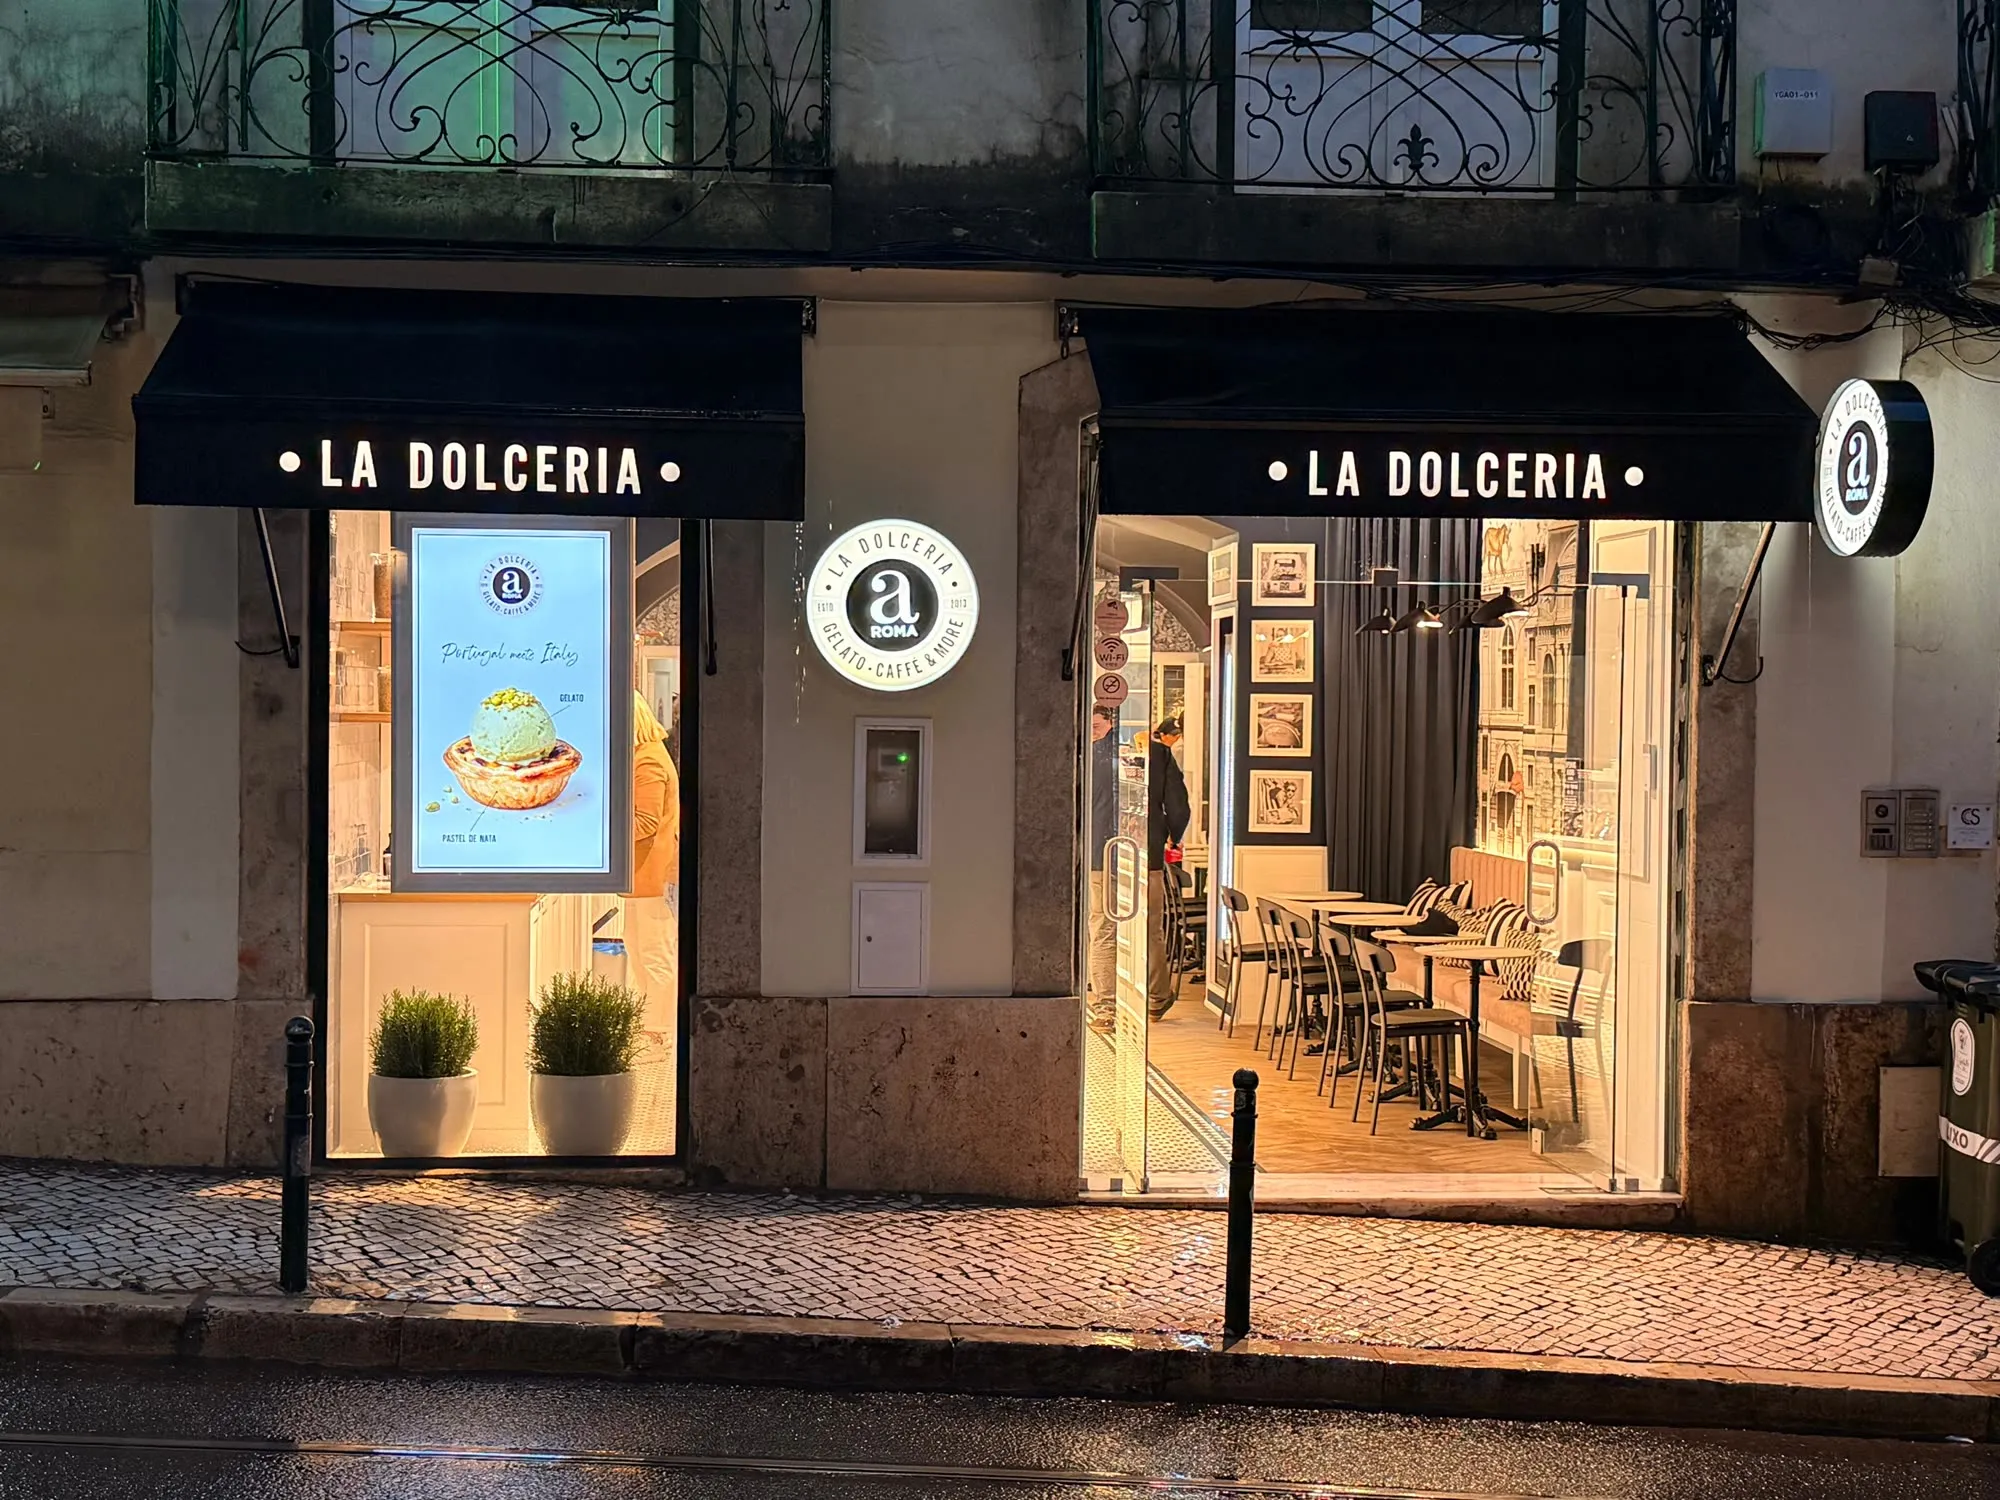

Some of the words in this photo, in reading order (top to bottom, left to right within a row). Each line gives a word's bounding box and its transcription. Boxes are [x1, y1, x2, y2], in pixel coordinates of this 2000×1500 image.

[321, 439, 378, 488] LA
[409, 441, 642, 495] DOLCERIA
[1308, 449, 1360, 497] LA
[1388, 450, 1607, 499] DOLCERIA
[828, 554, 853, 578] LA
[858, 531, 954, 576] DOLCERIA
[823, 623, 866, 671] GELATO
[925, 653, 937, 667] &
[934, 618, 964, 659] MORE
[870, 624, 919, 639] ROMA
[441, 642, 506, 667] Portugal
[540, 642, 579, 667] Italy
[559, 693, 585, 703] GELATO
[442, 834, 466, 843] PASTEL
[468, 834, 477, 843] DE
[479, 834, 497, 843] NATA
[1946, 1123, 1969, 1149] LIXO
